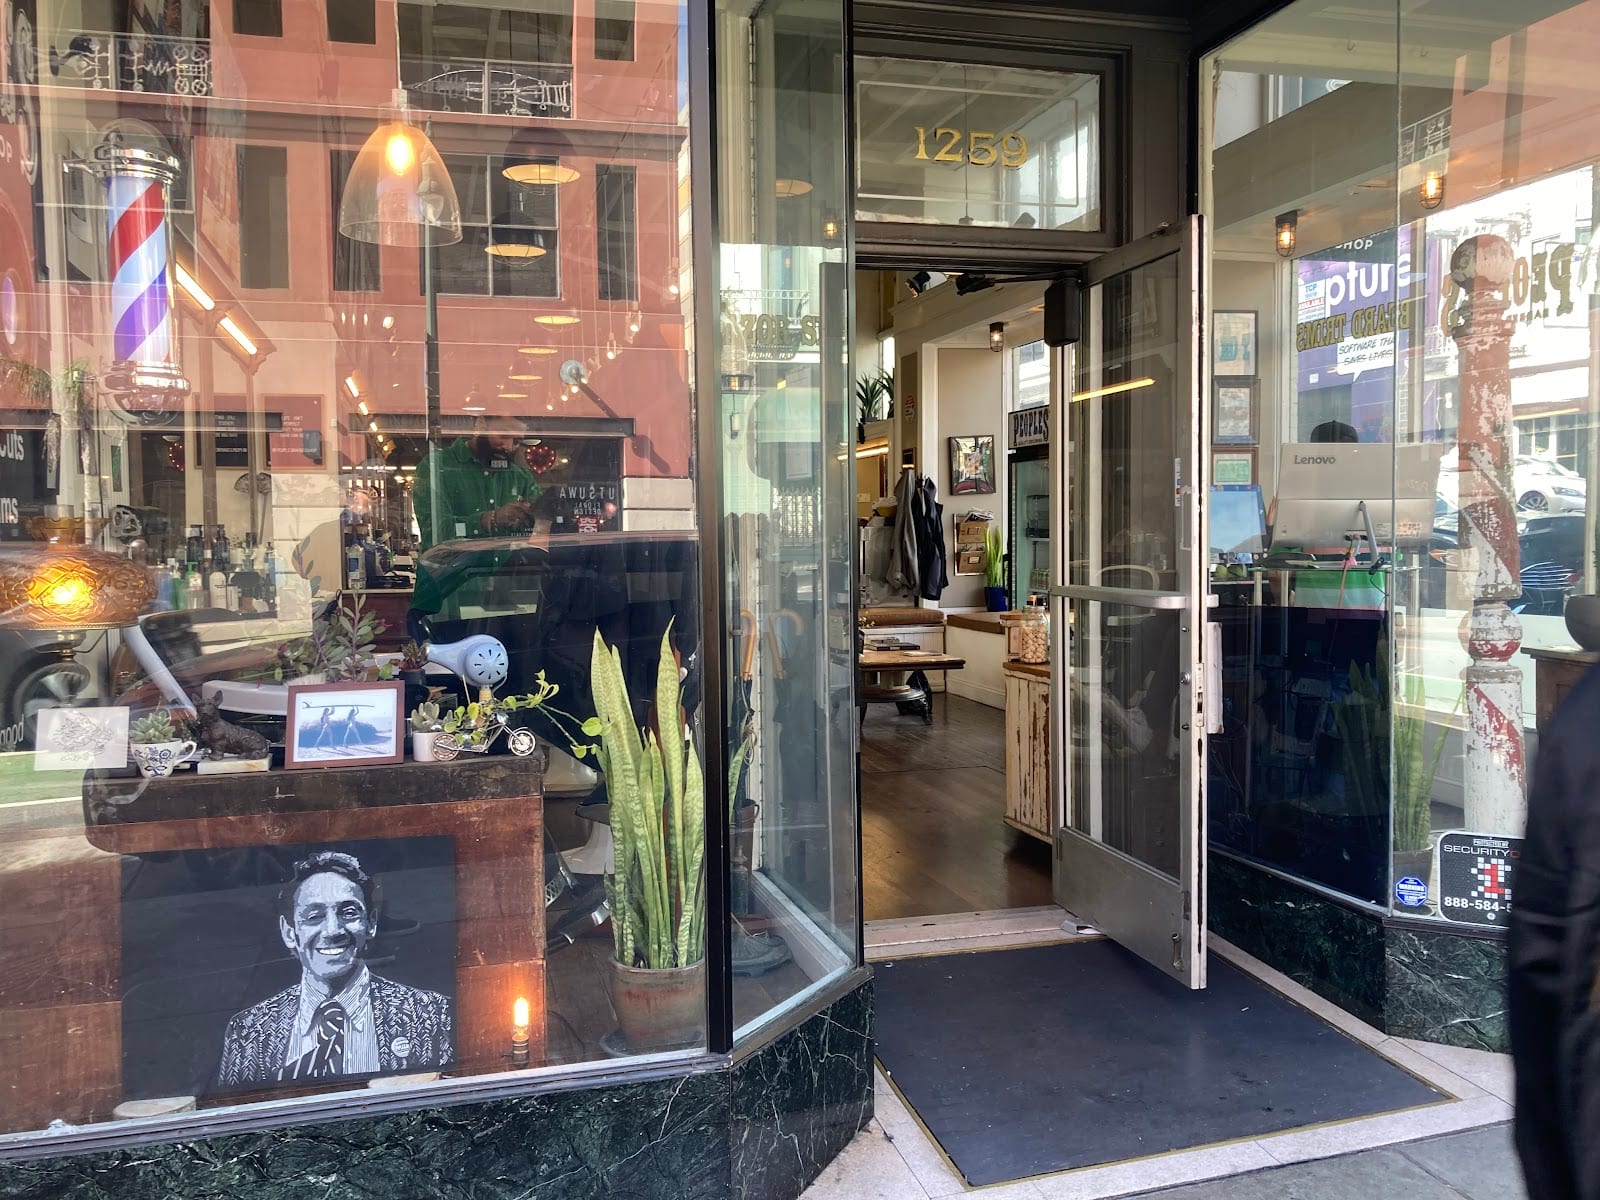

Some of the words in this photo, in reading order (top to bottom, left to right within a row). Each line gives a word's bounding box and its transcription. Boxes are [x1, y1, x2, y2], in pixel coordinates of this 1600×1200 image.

[914, 126, 1028, 167] 1259
[1336, 238, 1373, 251] HOP
[1338, 339, 1377, 355] SOFTWARE
[1013, 408, 1049, 446] PEOPLES
[1294, 454, 1336, 464] Lenovo
